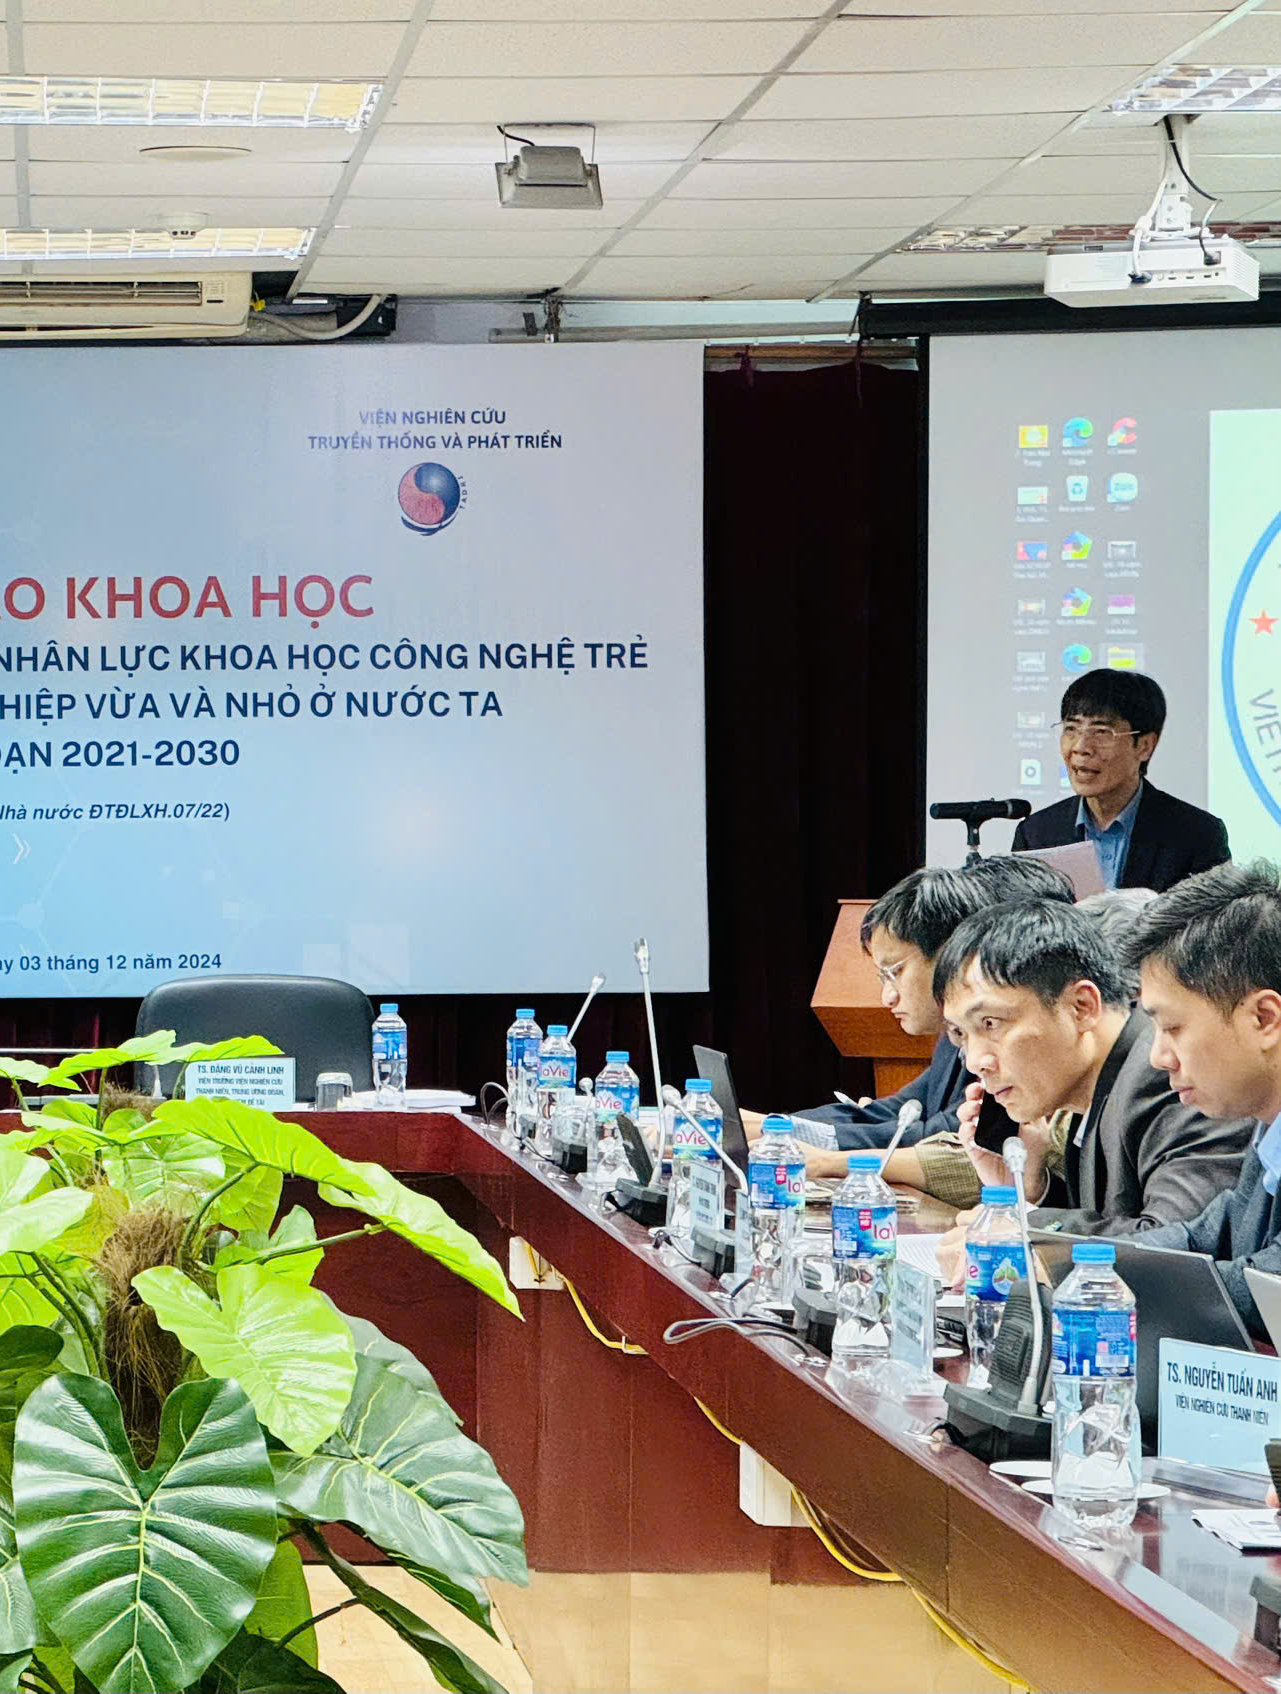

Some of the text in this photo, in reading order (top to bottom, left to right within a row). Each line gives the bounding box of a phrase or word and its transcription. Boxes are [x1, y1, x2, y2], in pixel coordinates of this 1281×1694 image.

[359, 407, 507, 428] VIỆN NGHIÊN CỨU
[307, 429, 562, 449] TRUYỀN THỐNG VÀ PHÁT TRIỂN
[66, 575, 232, 620] KHOA
[252, 574, 374, 630] HỌC
[100, 644, 170, 678] LỰC
[180, 644, 278, 671] KHOA
[287, 643, 360, 677] HỌC
[369, 637, 468, 670] CÔNG
[479, 636, 575, 676] NGHỆ
[583, 633, 648, 669] TRẺ
[84, 687, 161, 720] VỪA
[169, 686, 216, 719] VÀ
[225, 683, 301, 718] NHỎ
[310, 682, 337, 718] Ở
[346, 684, 450, 718] NƯỚC
[458, 690, 503, 717] TA
[62, 739, 240, 767] 2021-2030
[32, 803, 84, 820] nước
[89, 802, 230, 822] ĐTĐLXH.07/22)
[19, 955, 41, 971] 03
[46, 954, 99, 974] tháng
[106, 954, 127, 970] 12
[133, 953, 172, 970] năm
[178, 953, 222, 969] 2024
[198, 1065, 208, 1074] TS.
[266, 1066, 285, 1075] LINH
[1167, 1361, 1278, 1403] TS. NGUYỄN TUẤN ANH
[1230, 1405, 1252, 1422] THANH
